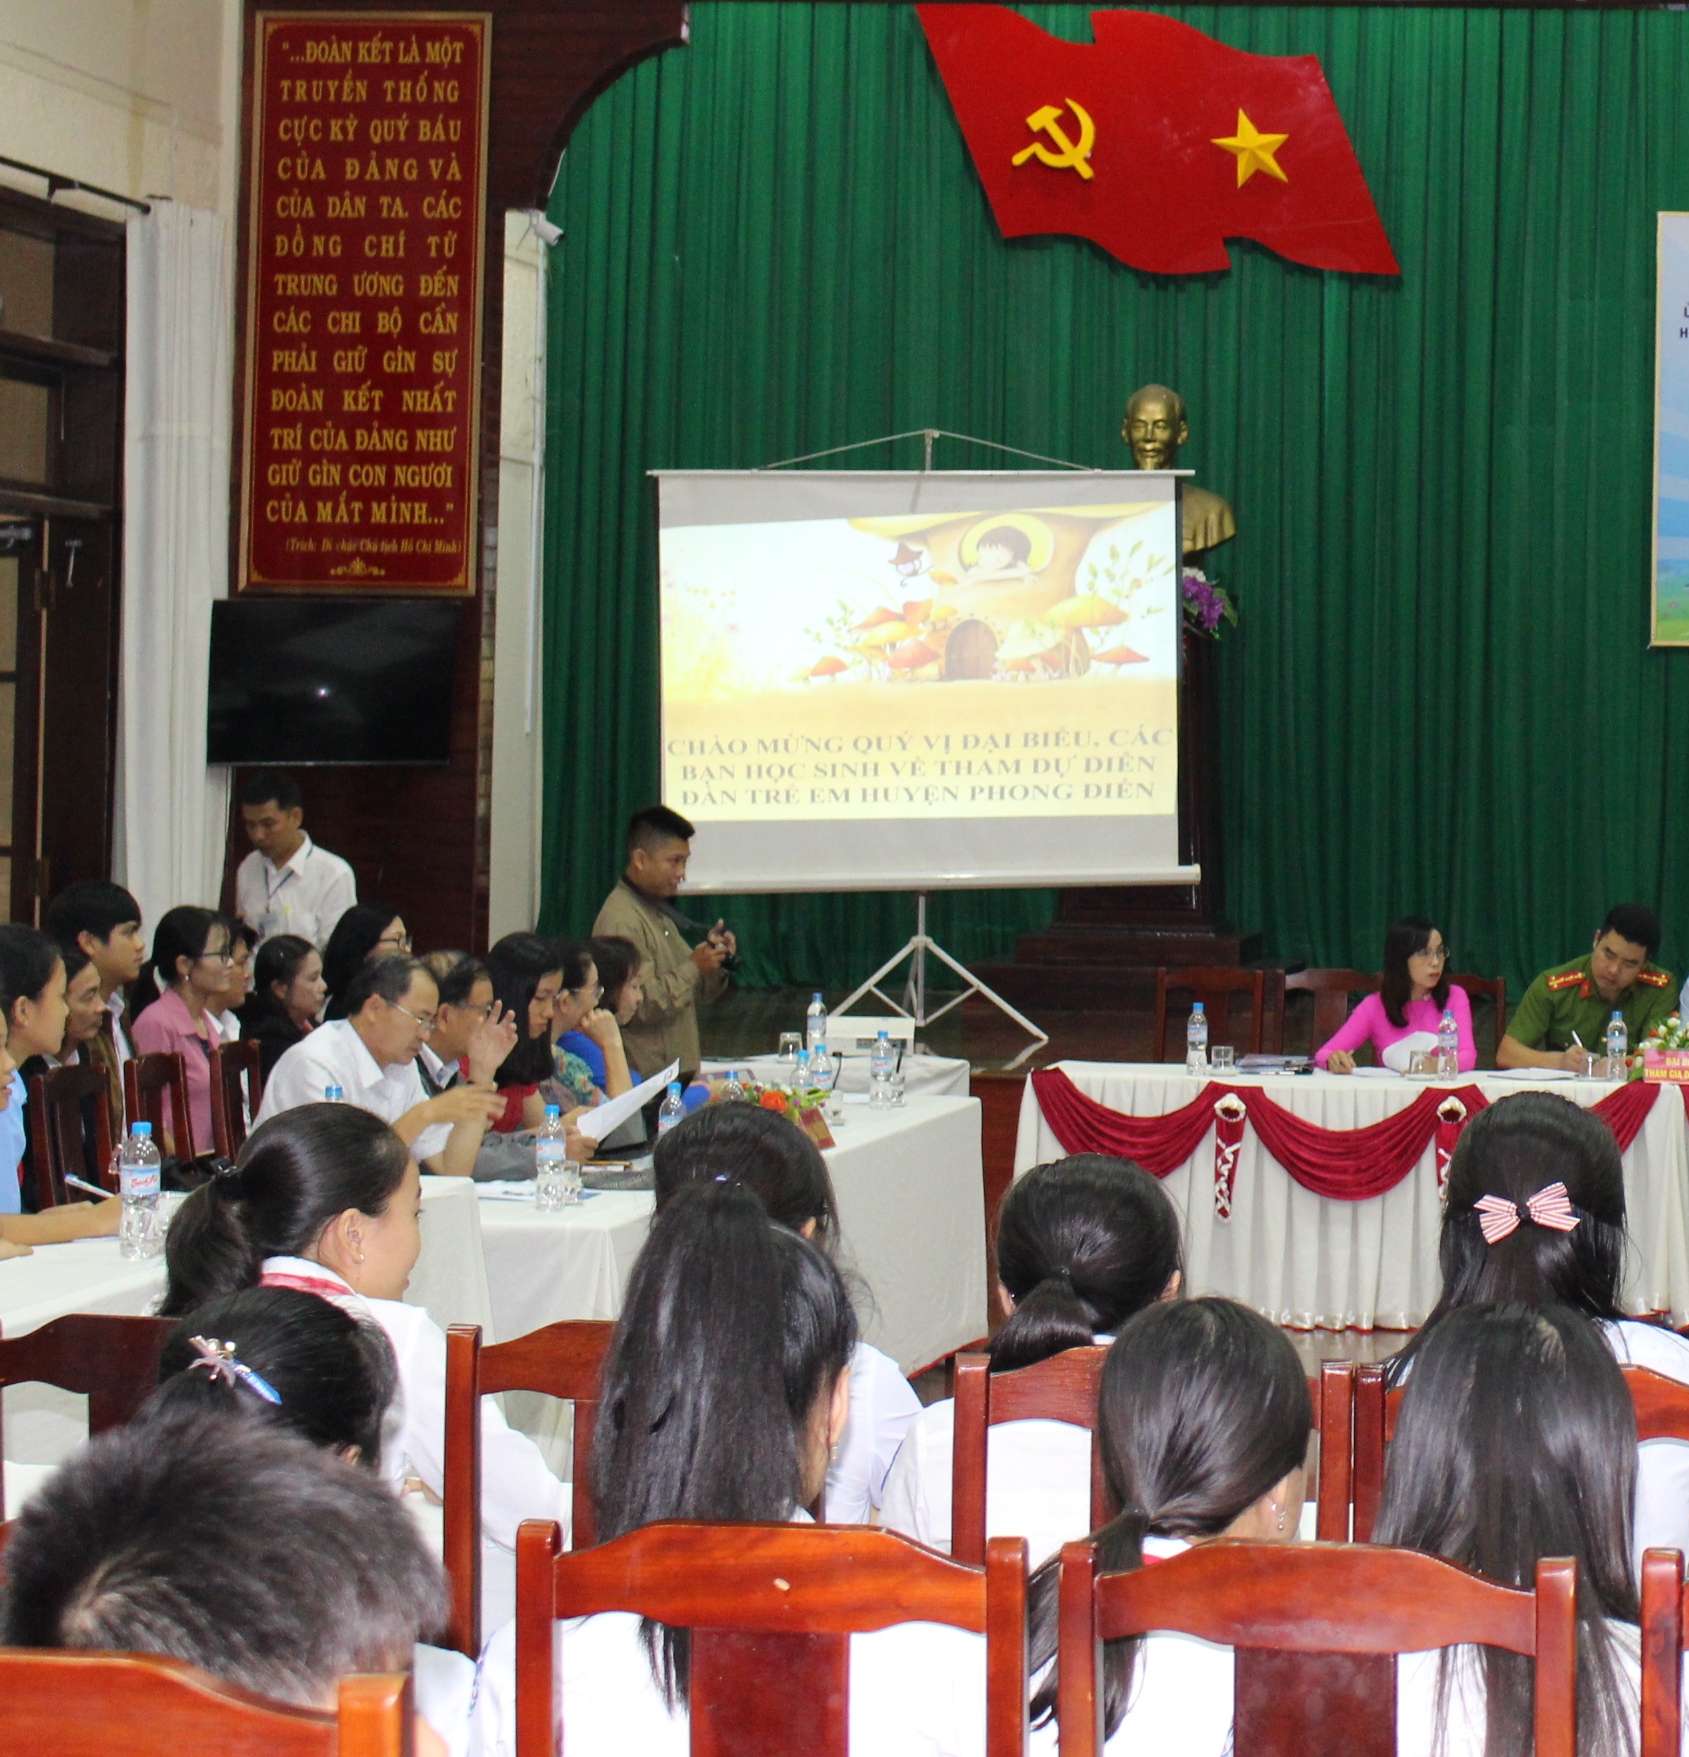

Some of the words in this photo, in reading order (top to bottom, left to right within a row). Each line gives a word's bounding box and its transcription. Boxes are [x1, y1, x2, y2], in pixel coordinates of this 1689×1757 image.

[358, 31, 393, 63] KẾT
[399, 35, 421, 64] LÀ
[426, 36, 464, 68] MỘT
[280, 69, 367, 102] TRUYỀN
[384, 70, 459, 103] THỐNG
[279, 116, 322, 147] CỰC
[330, 113, 358, 141] KỲ
[369, 113, 409, 144] QUÝ
[418, 113, 461, 142] BÁU
[278, 150, 326, 180] CỦA
[345, 151, 418, 181] ĐẢNG
[429, 152, 461, 180] VÀ
[277, 188, 315, 218] CỦA
[327, 191, 367, 218] DÂN
[423, 189, 461, 219] CÁC
[276, 224, 342, 257] ĐỒNG
[364, 230, 405, 257] CHÍ
[274, 274, 338, 296] TRUNG
[353, 271, 404, 297] ƯƠNG
[419, 265, 459, 297] ĐẾN
[273, 305, 311, 333] CÁC
[327, 311, 361, 334] CHI
[377, 306, 402, 338] BỘ
[272, 343, 317, 372] PHẢI
[383, 346, 416, 373] GÌN
[433, 348, 458, 378] SỰ
[271, 382, 324, 411] ĐOÀN
[343, 380, 383, 412] KẾT
[402, 380, 457, 413] NHẤT
[270, 423, 302, 450] TRÍ
[310, 421, 349, 451] CỦA
[355, 421, 408, 452] ĐẢNG
[415, 426, 457, 452] NHƯ
[308, 459, 341, 486] GÌN
[348, 464, 386, 487] CON
[267, 493, 308, 523] CỦA
[317, 490, 363, 523] MẮT
[667, 736, 747, 756] CHÀO
[758, 734, 843, 754] MỪNG
[853, 729, 914, 755] QUÝ
[924, 735, 950, 754] VỊ
[962, 733, 1010, 753] ĐẠI
[1109, 725, 1172, 746] CÁC
[682, 765, 734, 784] BẠN
[746, 765, 805, 783] HỌC
[814, 762, 879, 778] SINH
[935, 759, 1021, 776] THAM
[810, 789, 849, 803] EM
[971, 785, 1072, 801] PHONG
